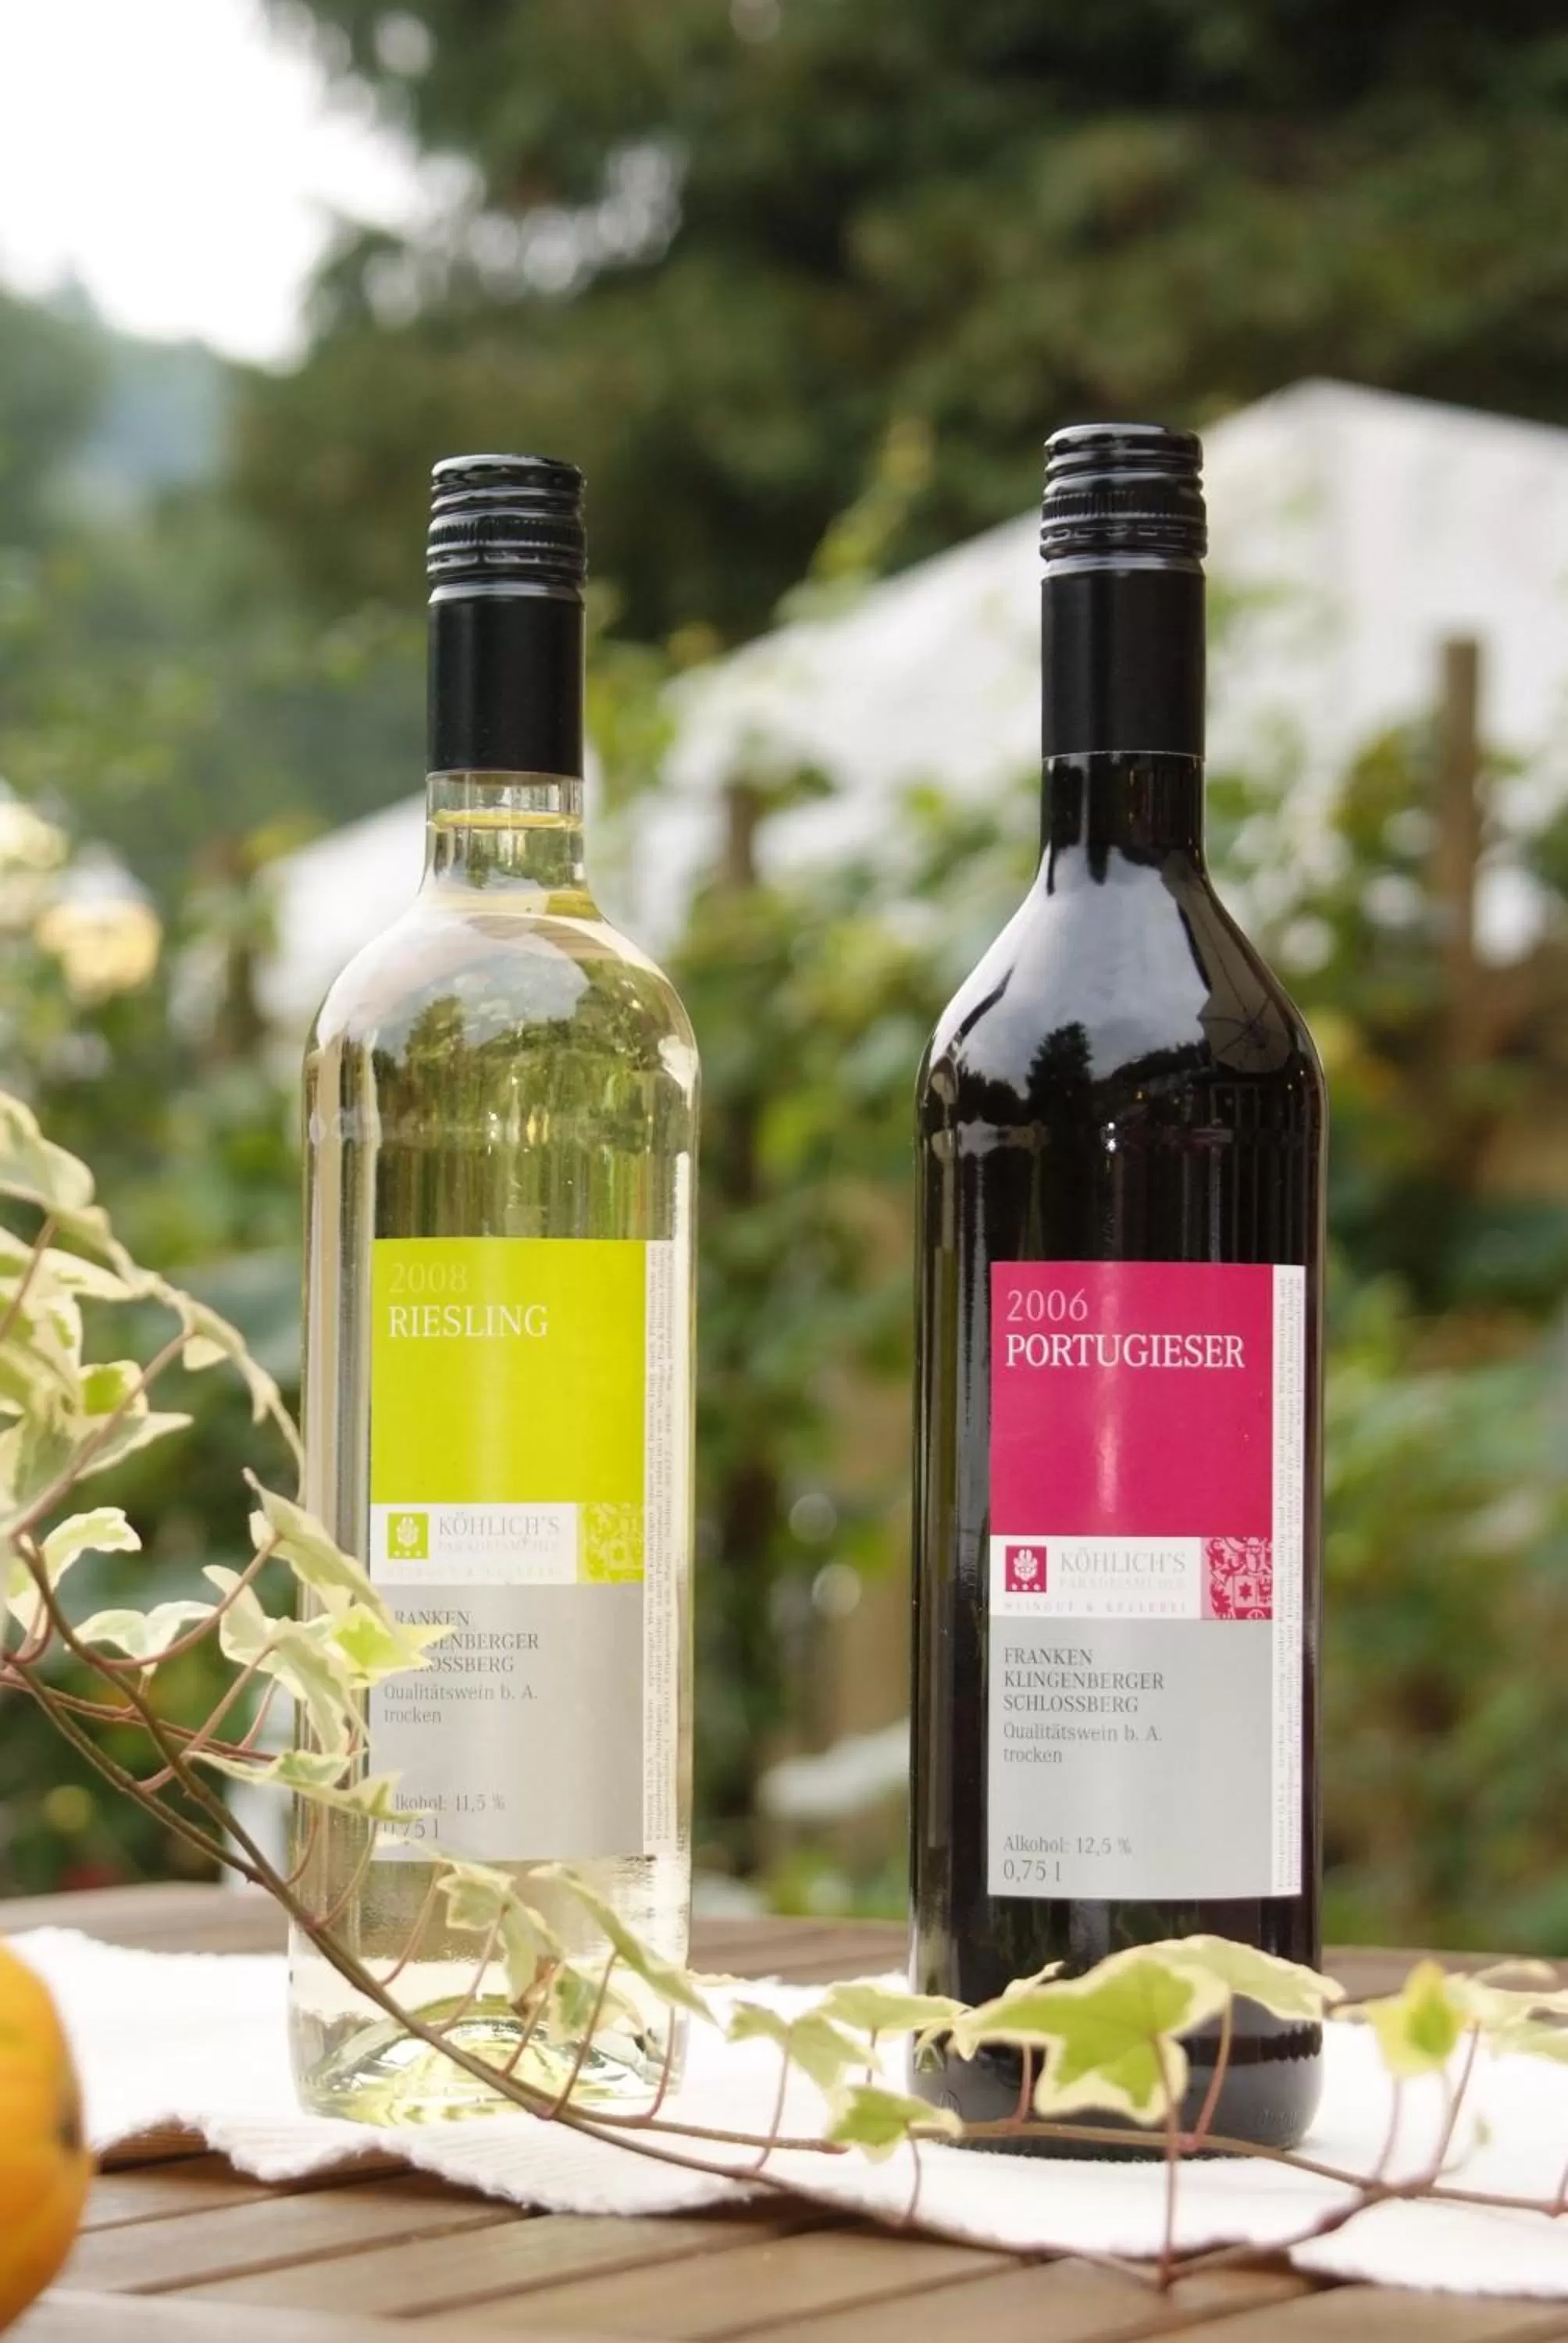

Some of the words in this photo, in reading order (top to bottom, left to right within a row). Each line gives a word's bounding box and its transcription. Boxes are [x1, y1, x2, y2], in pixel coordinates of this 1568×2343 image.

[388, 1262, 468, 1293] 2008
[1006, 1289, 1089, 1322] 2006
[388, 1304, 549, 1338] RIESLING
[1005, 1333, 1245, 1368] PORTUGIESER
[394, 1610, 472, 1626] RANKEN
[412, 1655, 515, 1674] OSSBERG
[1003, 1647, 1093, 1666] FRANKEN
[383, 1681, 494, 1700] Qualitätswein
[500, 1682, 515, 1700] b.
[521, 1683, 538, 1700] A.
[1003, 1671, 1165, 1691] KLINGENBERGER
[1003, 1694, 1139, 1714] SCHLOSSBERG
[383, 1706, 442, 1724] trocken
[1003, 1721, 1119, 1742] Qualitätswein
[1124, 1724, 1140, 1742] b.
[1147, 1724, 1164, 1742] A.
[1003, 1746, 1063, 1764] trocken
[394, 1792, 447, 1812] lkohol:
[455, 1793, 487, 1813] 11,5
[1003, 1834, 1069, 1853] Alkohol:
[1076, 1836, 1113, 1855] 12,5
[1117, 1836, 1133, 1855] %
[1003, 1858, 1047, 1883] 0,75
